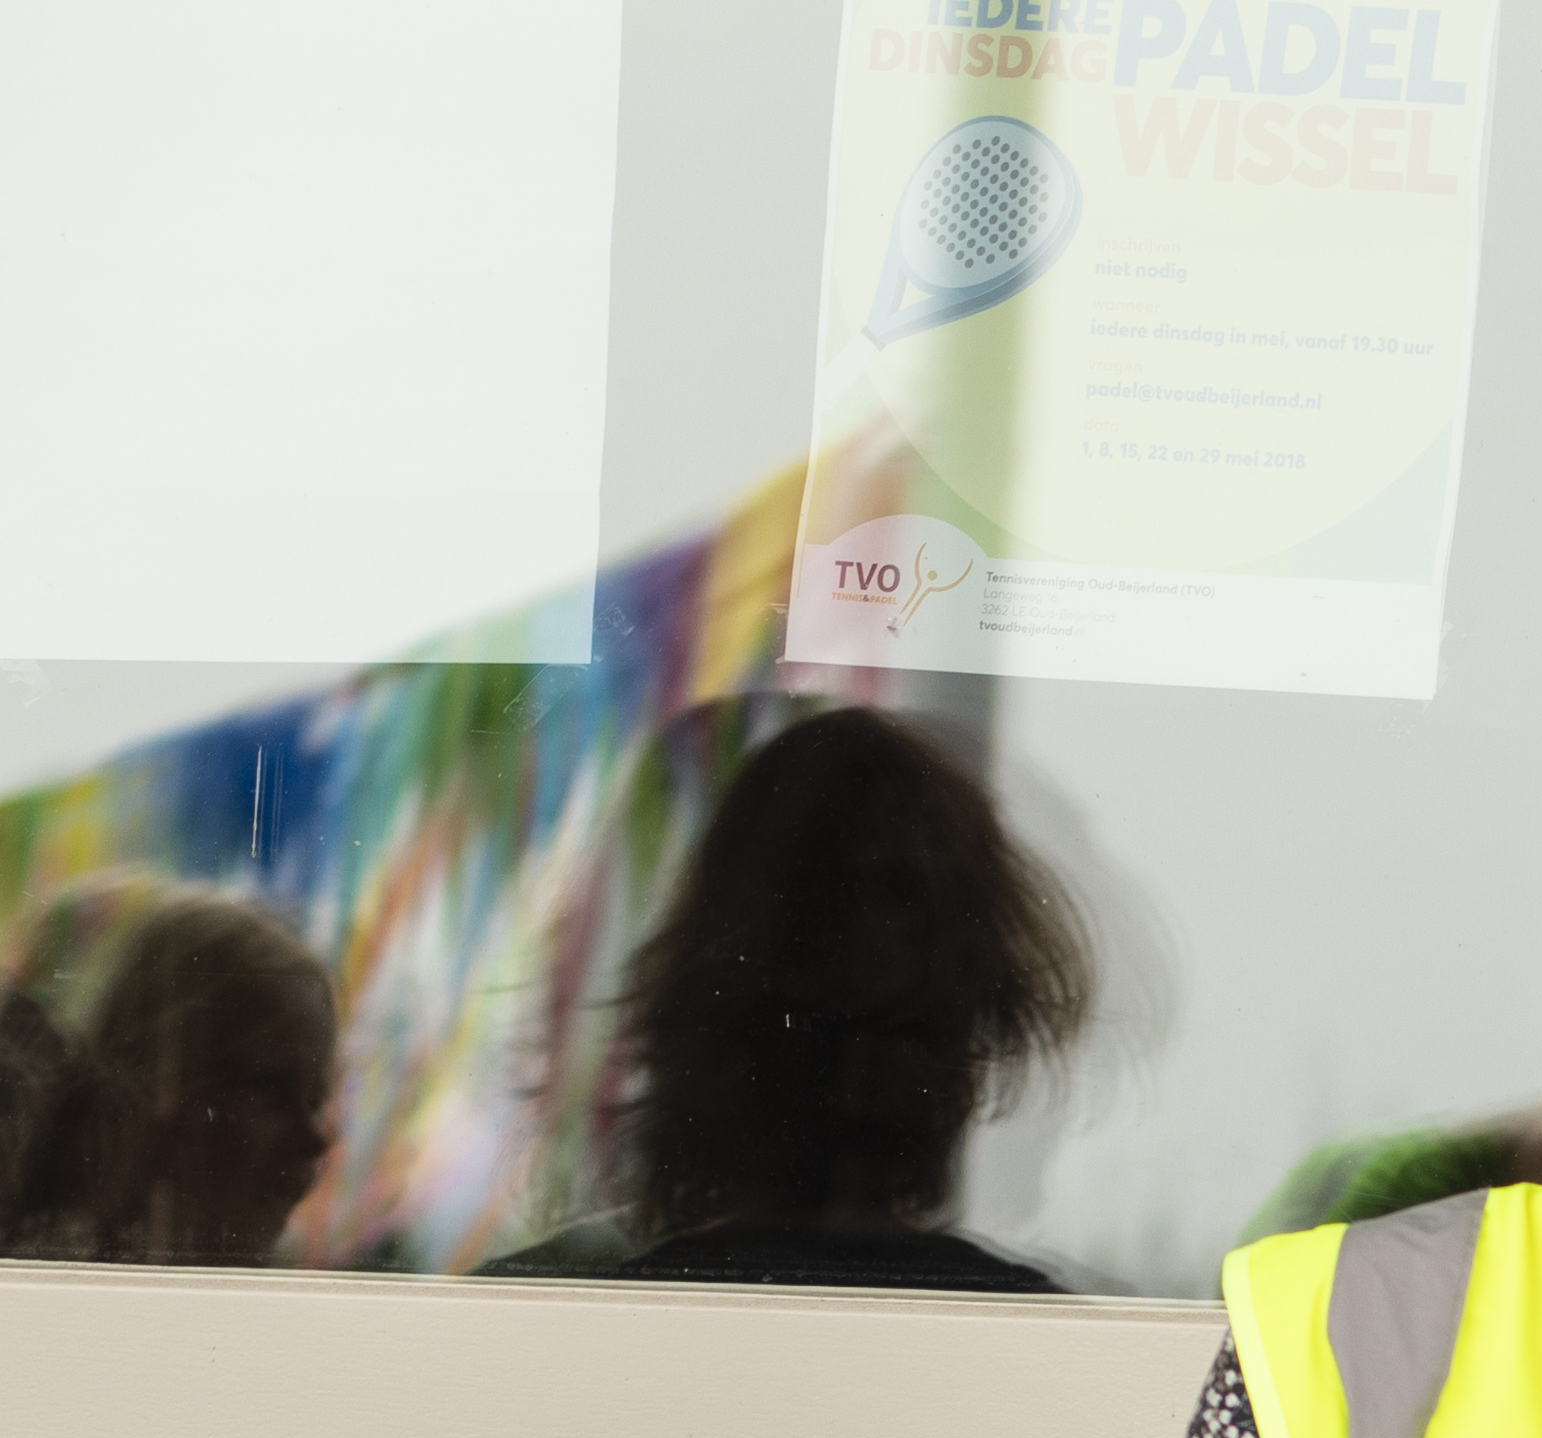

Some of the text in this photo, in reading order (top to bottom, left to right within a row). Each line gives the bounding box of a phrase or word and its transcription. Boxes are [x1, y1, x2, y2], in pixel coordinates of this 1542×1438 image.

[868, 28, 1108, 83] DINSDAG
[1113, 0, 1467, 104] PADEL
[1111, 93, 1460, 195] WISSEL
[1097, 236, 1181, 255] inschrijven
[1095, 259, 1188, 284] niet nodig
[1093, 299, 1161, 314] wanneer
[1090, 318, 1434, 356] iedere dinsdag in mei, vanaf 19.30 uur
[1088, 359, 1143, 376] vragen
[1086, 381, 1322, 410] padel@tvoudbeijerland.nl
[1083, 417, 1120, 433] data
[1081, 440, 1306, 470] 1, 8, 15, 22 en 29 mei 2018
[835, 560, 900, 593] TVO
[985, 571, 1216, 599] Tennisvereniging Oud-Beijerland (TVO)
[981, 604, 1009, 618] 3262
